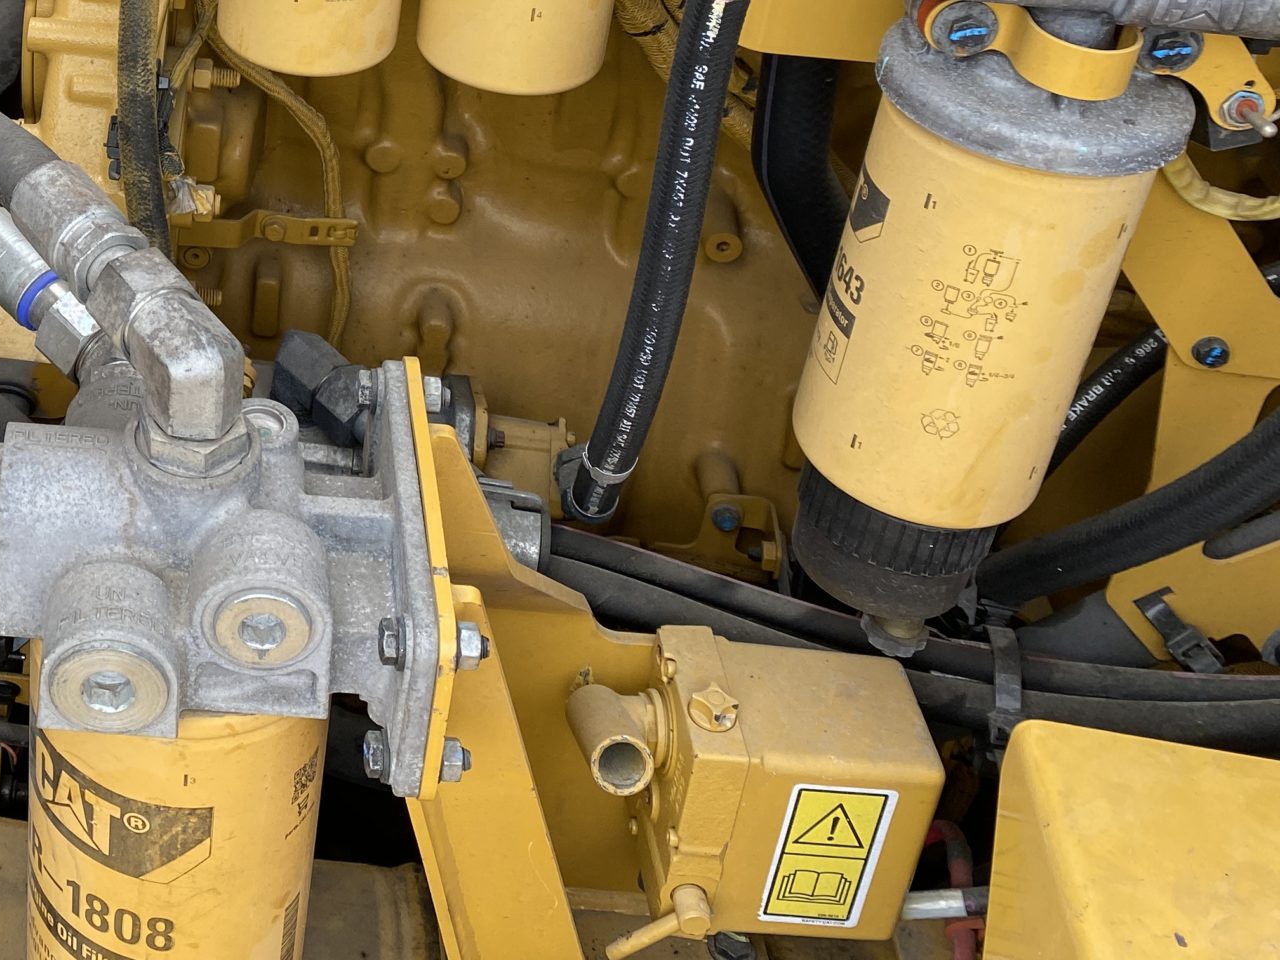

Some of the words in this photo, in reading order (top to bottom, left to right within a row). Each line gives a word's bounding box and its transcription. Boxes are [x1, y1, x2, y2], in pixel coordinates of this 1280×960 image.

[1068, 385, 1104, 422] BRAKE
[35, 735, 121, 857] CAT
[32, 821, 176, 952] R-1808
[57, 922, 78, 952] Oil
